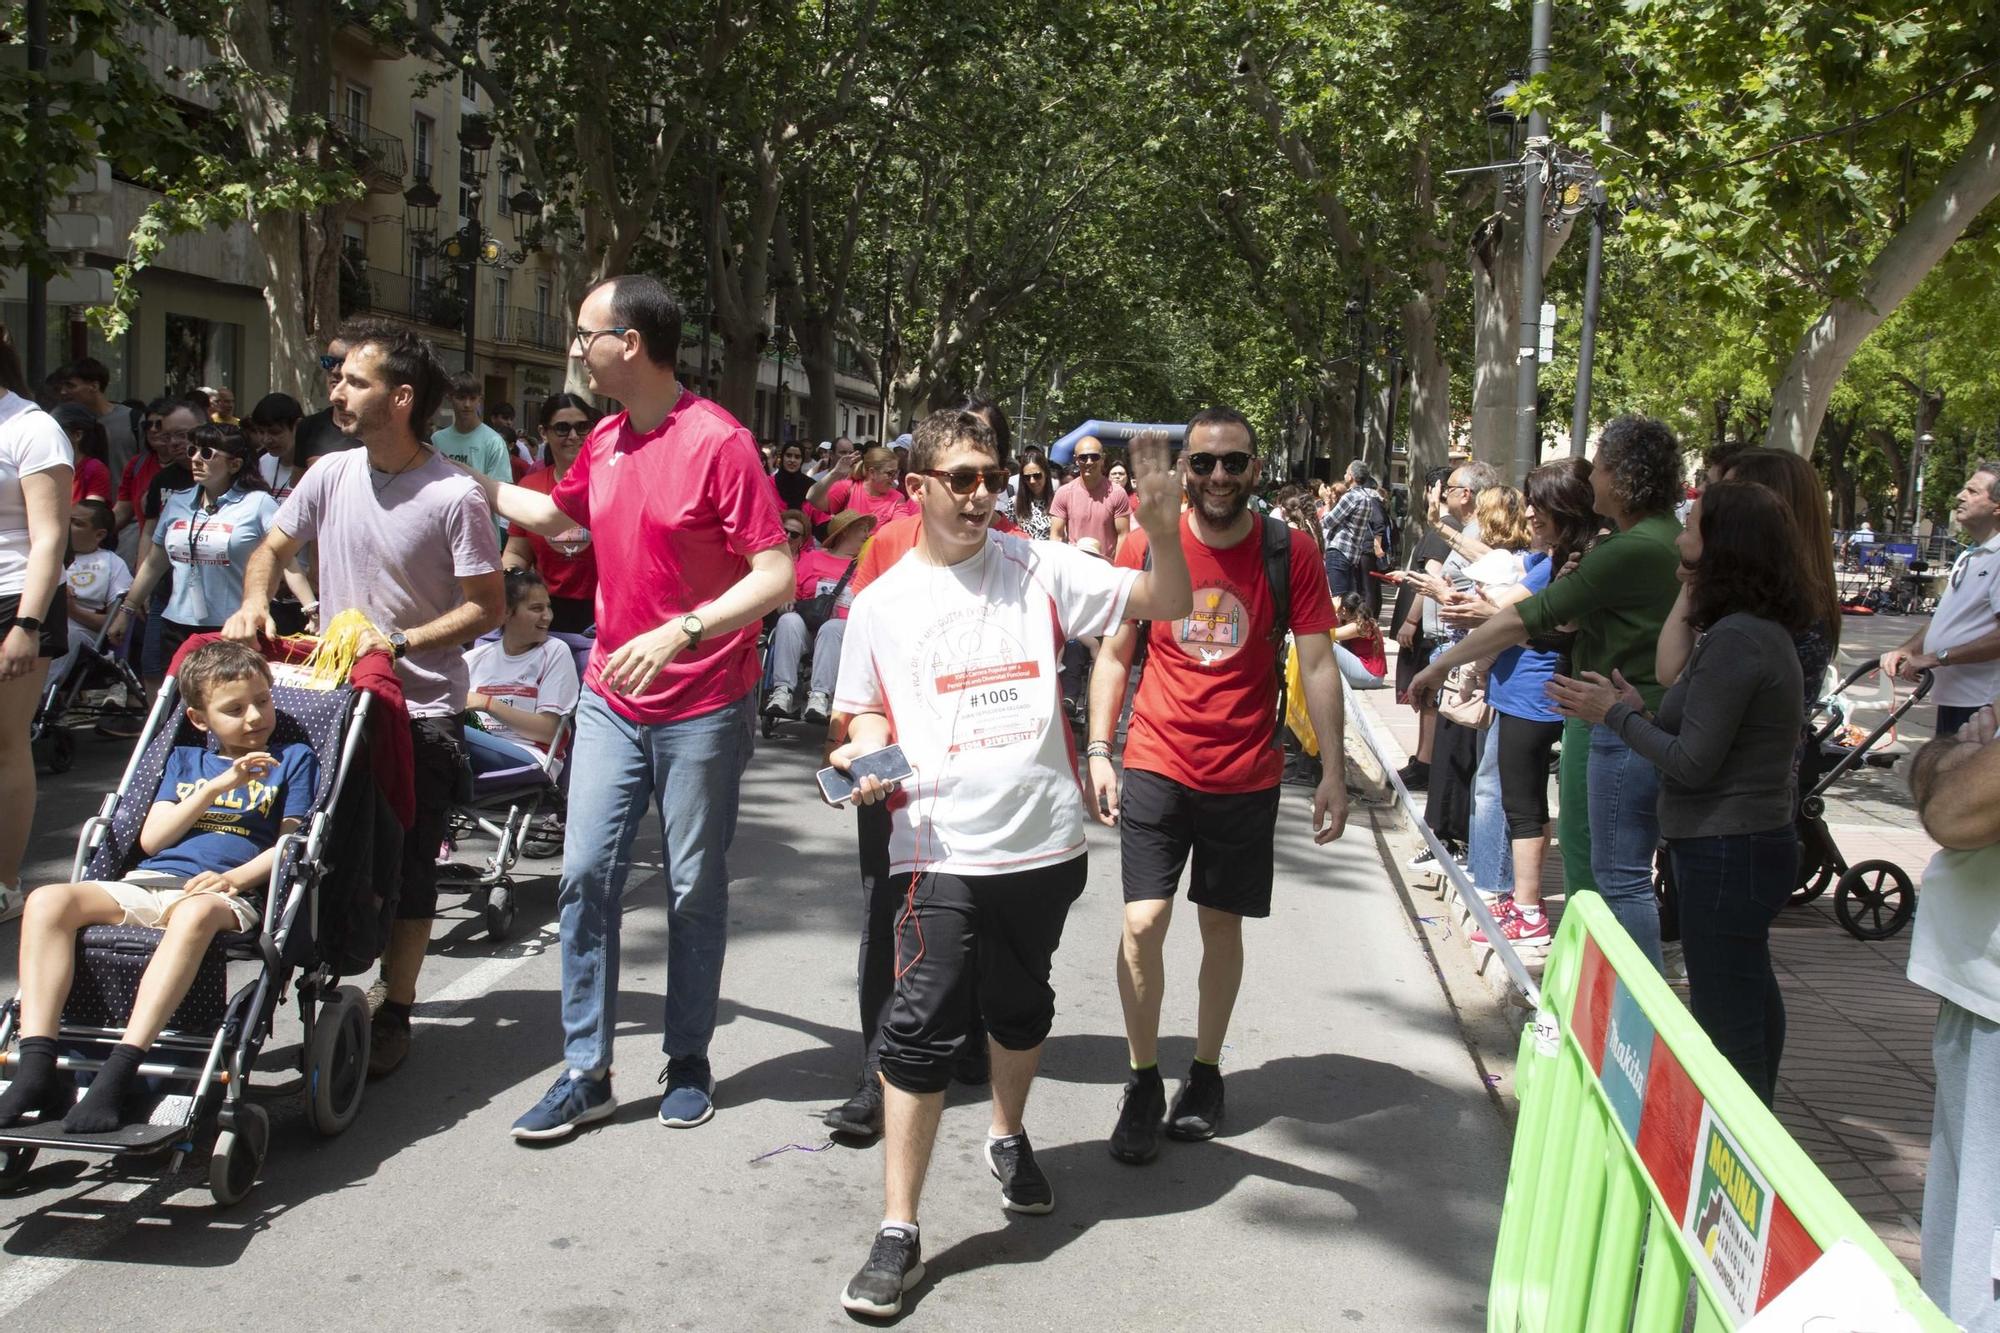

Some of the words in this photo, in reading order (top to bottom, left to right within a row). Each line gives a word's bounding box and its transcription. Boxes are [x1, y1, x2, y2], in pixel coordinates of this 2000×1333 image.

[970, 688, 1018, 707] #1005
[1610, 1018, 1643, 1100] makita
[1708, 1132, 1757, 1232] MOLINA
